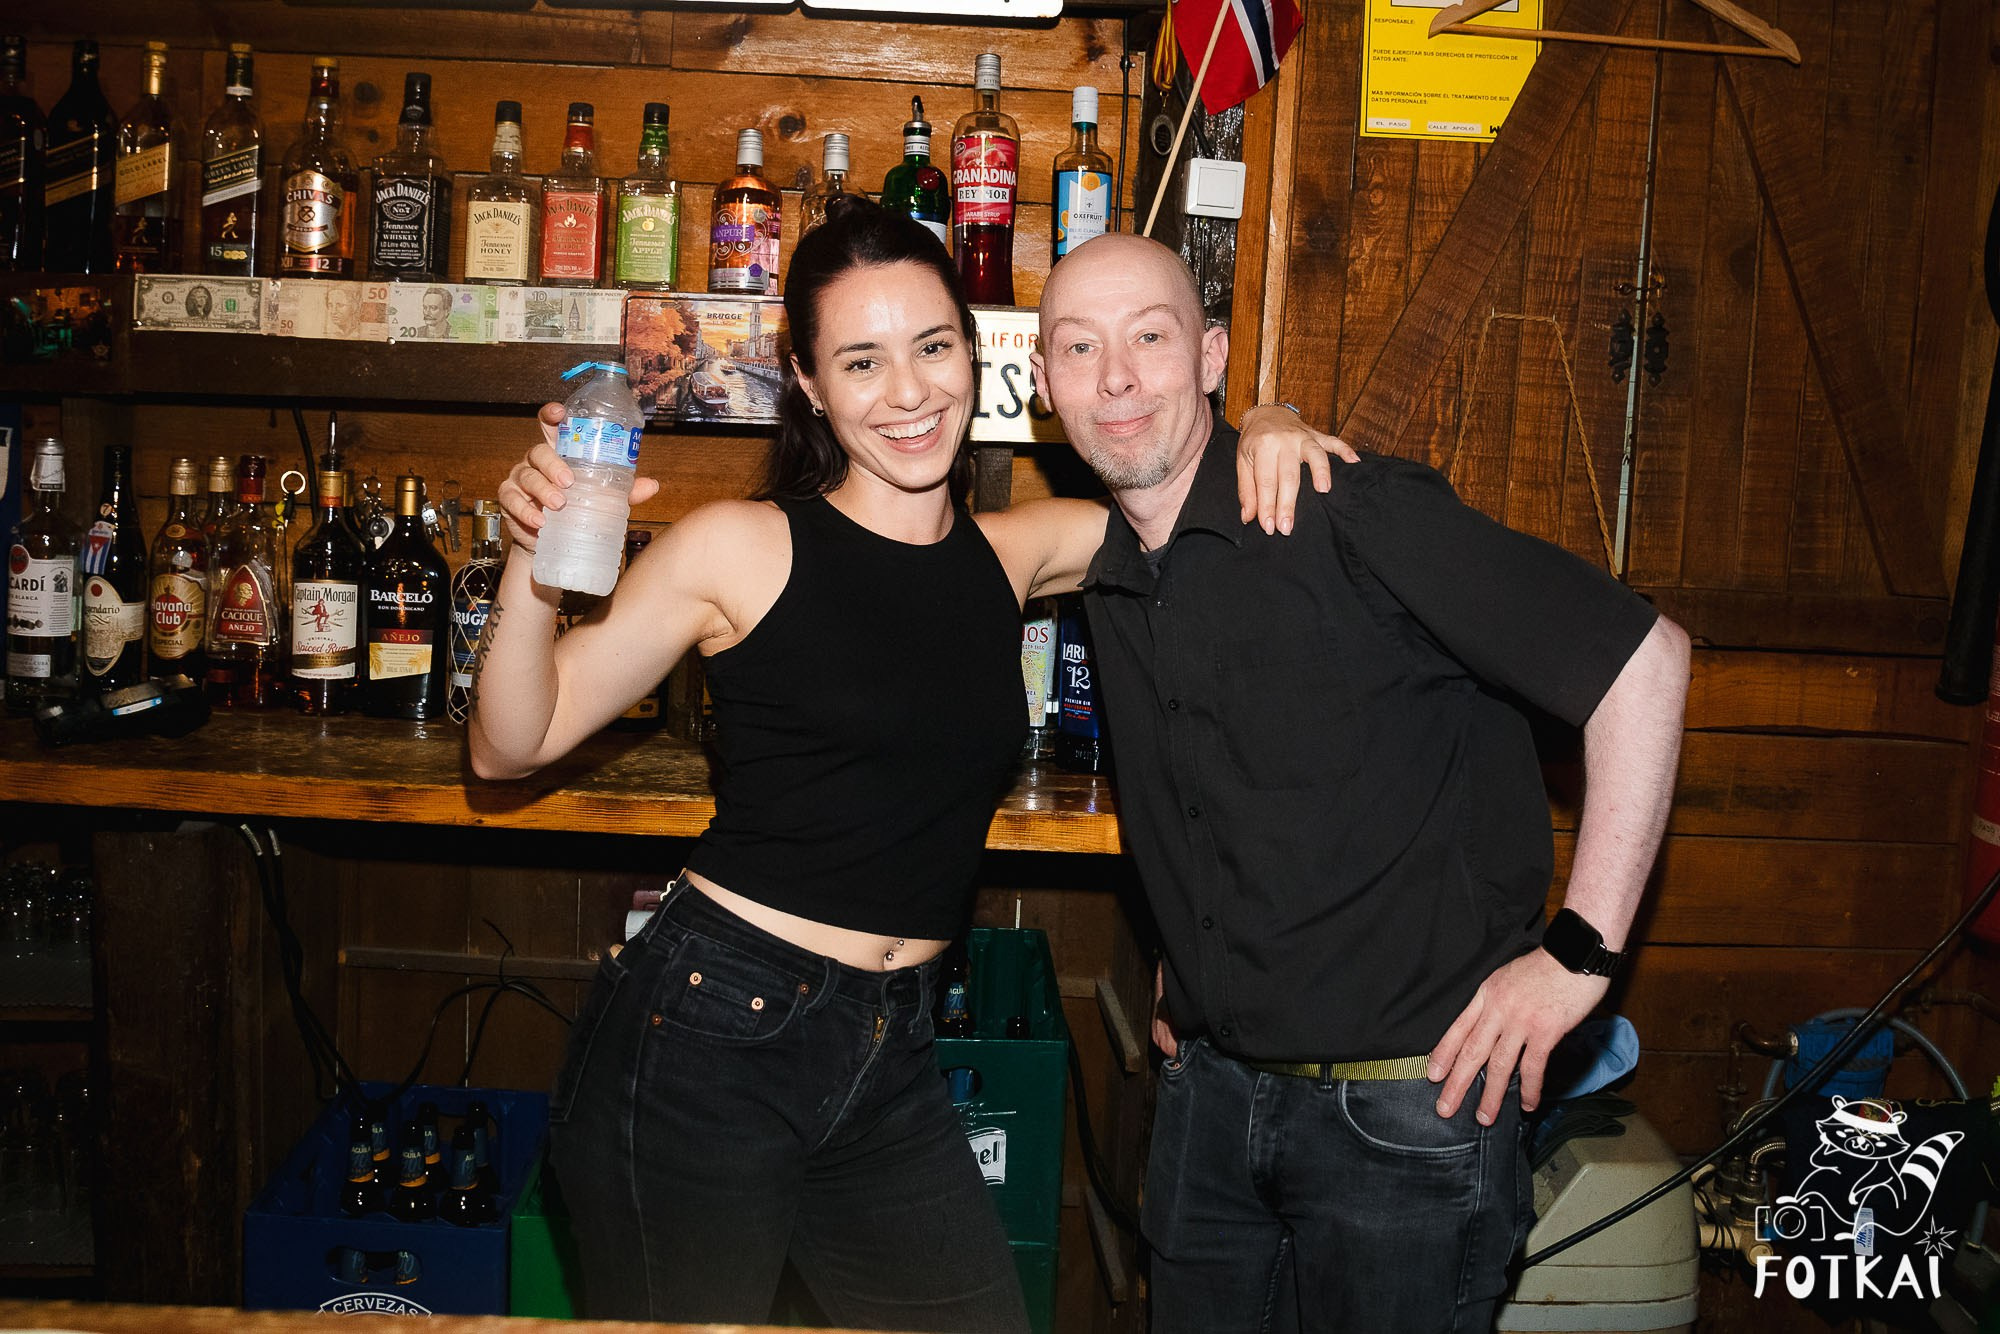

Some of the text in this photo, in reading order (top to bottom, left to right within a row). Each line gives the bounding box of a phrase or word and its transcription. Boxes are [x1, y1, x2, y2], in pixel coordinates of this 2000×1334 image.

[1451, 93, 1490, 101] TRATAMIENTO
[119, 164, 140, 177] GOLD
[204, 165, 232, 179] GREEN
[953, 168, 1016, 186] GRANADINA
[286, 189, 335, 204] CHIVAS
[375, 182, 432, 206] JACK DANIEL'S
[959, 189, 977, 200] REY
[473, 207, 523, 226] JACK DANIEL'S
[622, 206, 644, 223] JACK
[382, 221, 420, 230] Tennessee
[480, 239, 513, 248] Tennessee
[210, 246, 222, 257] 15
[631, 246, 663, 254] APPLE
[317, 258, 330, 269] 12
[368, 288, 388, 300] 50
[531, 291, 548, 302] 10
[707, 312, 743, 320] BRUGGE
[280, 319, 294, 329] 50
[400, 327, 417, 338] 20
[294, 585, 357, 605] Captain Morgan
[370, 589, 434, 604] BARCELÓ
[155, 611, 181, 625] Club
[221, 610, 264, 622] CACIQUE
[228, 622, 255, 633] AÑEJO
[381, 631, 420, 642] AÑEJO
[295, 641, 350, 655] Spiced Rum
[1062, 642, 1088, 663] LARI
[1066, 666, 1091, 690] 12
[332, 1297, 419, 1317] CERVEZAS
